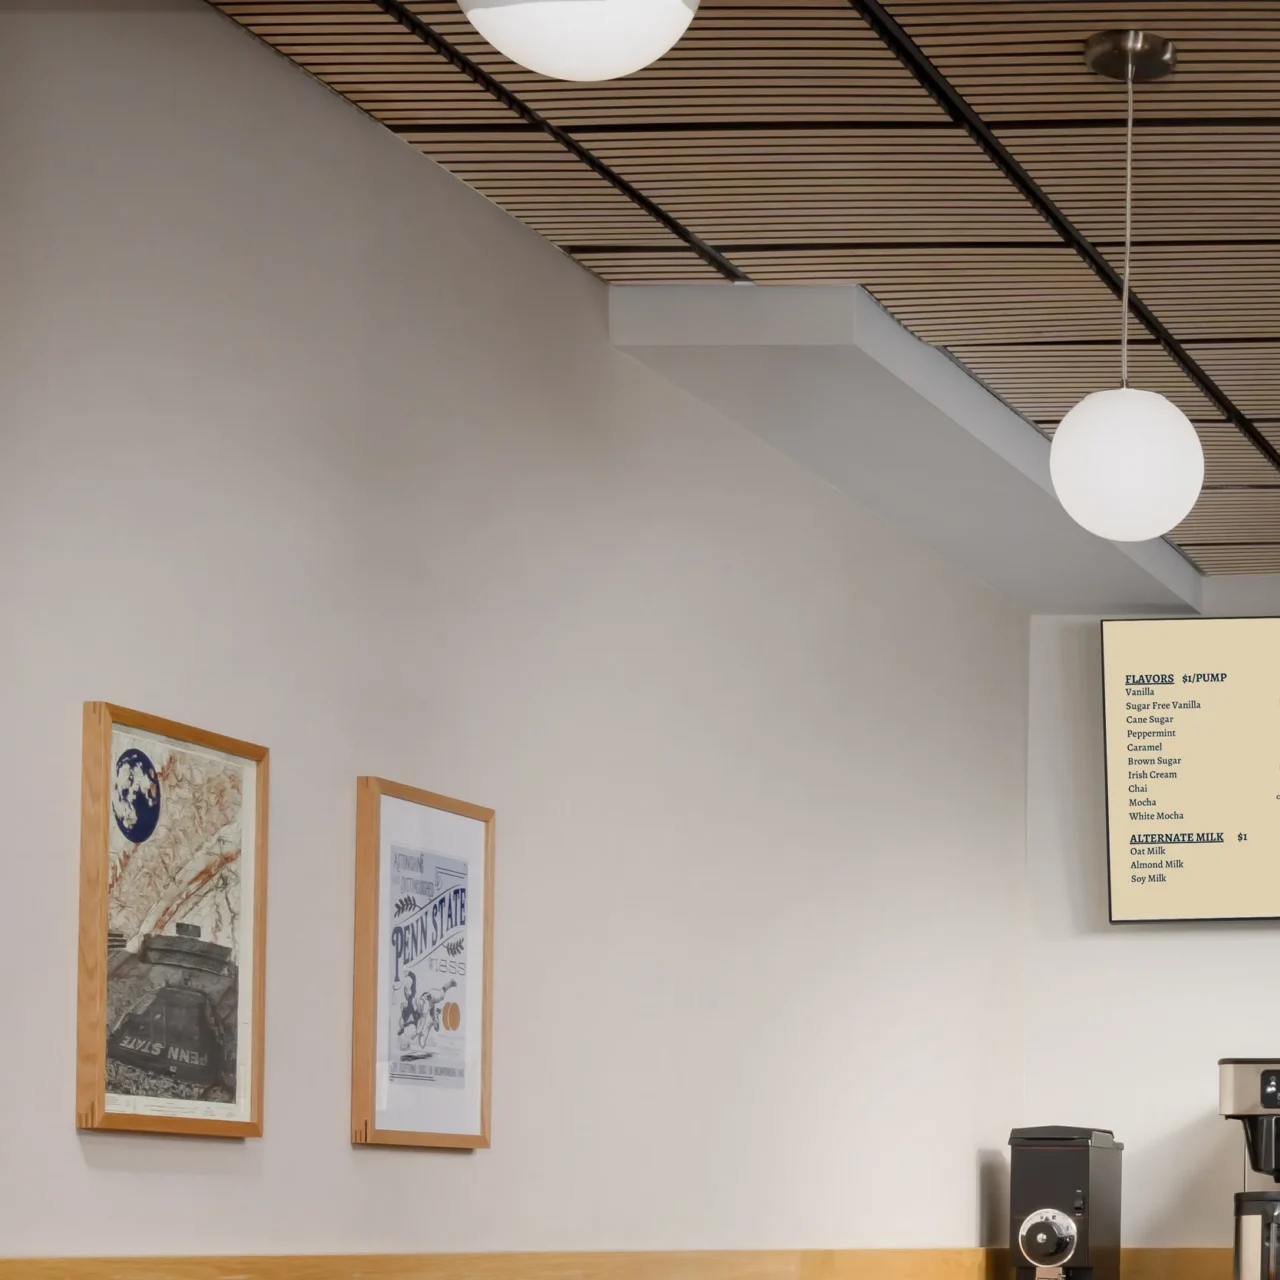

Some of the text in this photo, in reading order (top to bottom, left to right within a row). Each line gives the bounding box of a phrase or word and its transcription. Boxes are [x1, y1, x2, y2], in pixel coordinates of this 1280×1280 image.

[1126, 673, 1227, 684] FLAVORS $1/PUMP
[1125, 687, 1155, 696] Vanilla
[1126, 700, 1201, 713] Sugar Free Vanilla
[1126, 715, 1174, 726] Cane Sugar
[1127, 728, 1176, 740] Peppermint
[1127, 742, 1162, 752] Caramel
[1128, 756, 1182, 767] Brown Sugar
[1128, 784, 1148, 793] Chai
[1129, 797, 1157, 807] Mocha
[1129, 811, 1184, 821] White Mocha
[1130, 832, 1248, 843] ALTERNATE MILK $1
[1130, 859, 1184, 869] Almond Milk
[391, 887, 467, 983] PENN STATE
[119, 1035, 209, 1067] PENN STATE
